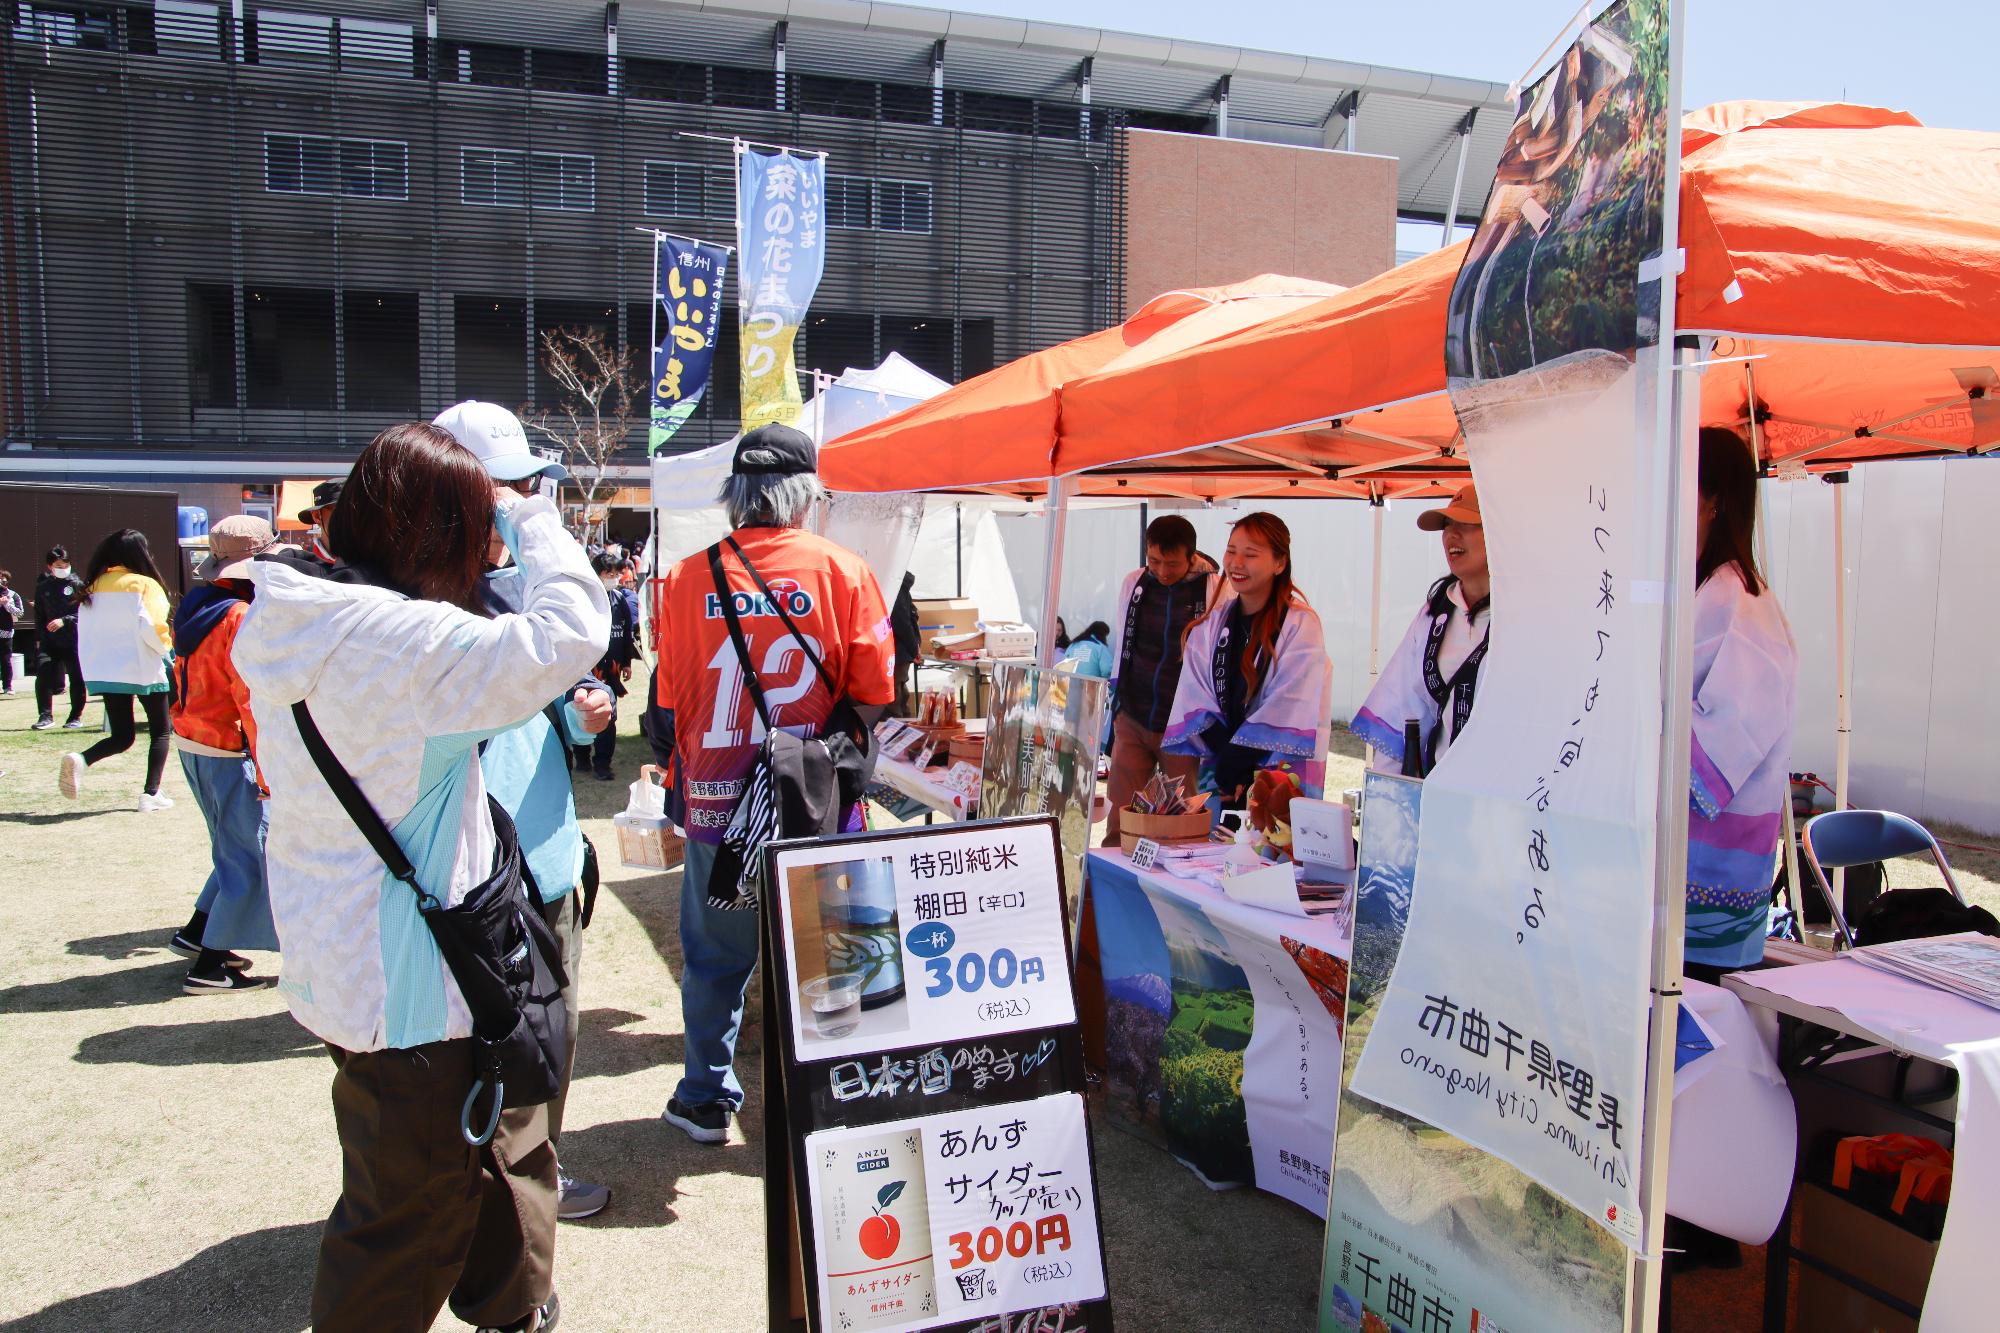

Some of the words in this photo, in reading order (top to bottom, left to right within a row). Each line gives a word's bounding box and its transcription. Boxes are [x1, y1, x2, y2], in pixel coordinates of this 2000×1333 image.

[799, 170, 820, 249] いいやま
[678, 251, 711, 271] 信州
[748, 163, 798, 378] 菜の花まつり
[702, 633, 825, 749] 12
[910, 844, 1019, 880] 特別純米
[913, 891, 968, 921] 棚田
[913, 931, 948, 949] 一杯
[924, 948, 1045, 998] 300円
[857, 1148, 887, 1159] ANZU
[939, 1118, 1028, 1158] あんず
[859, 1160, 887, 1170] CIDER
[944, 1161, 1062, 1204] サイダー
[949, 1212, 1072, 1270] 300円
[847, 1272, 921, 1296] あんずサイダー
[1354, 1251, 1455, 1333] 千曲市
